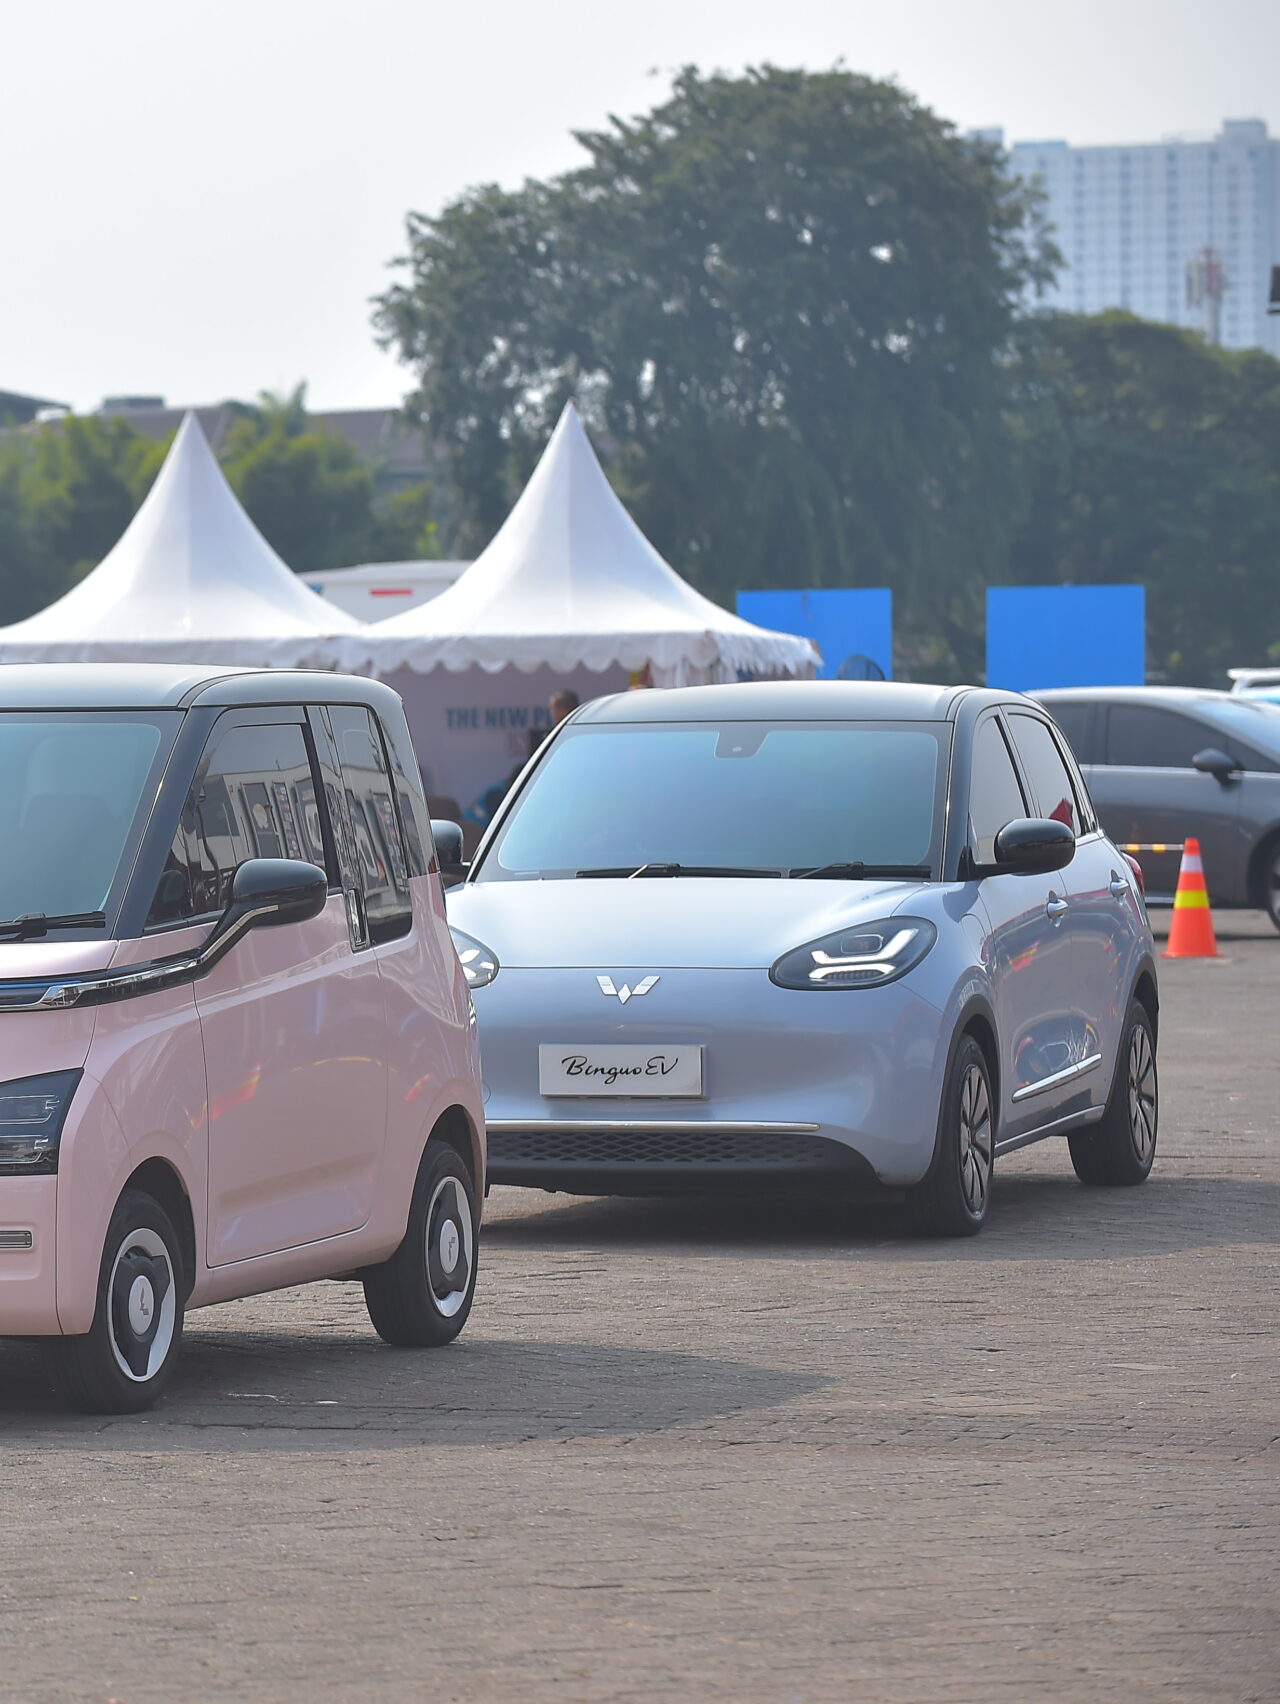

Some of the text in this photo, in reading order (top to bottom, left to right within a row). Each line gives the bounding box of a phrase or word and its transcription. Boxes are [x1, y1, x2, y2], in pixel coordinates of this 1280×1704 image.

[445, 706, 479, 729] THE
[485, 706, 528, 729] NEW
[561, 1055, 679, 1085] Binguo EV
